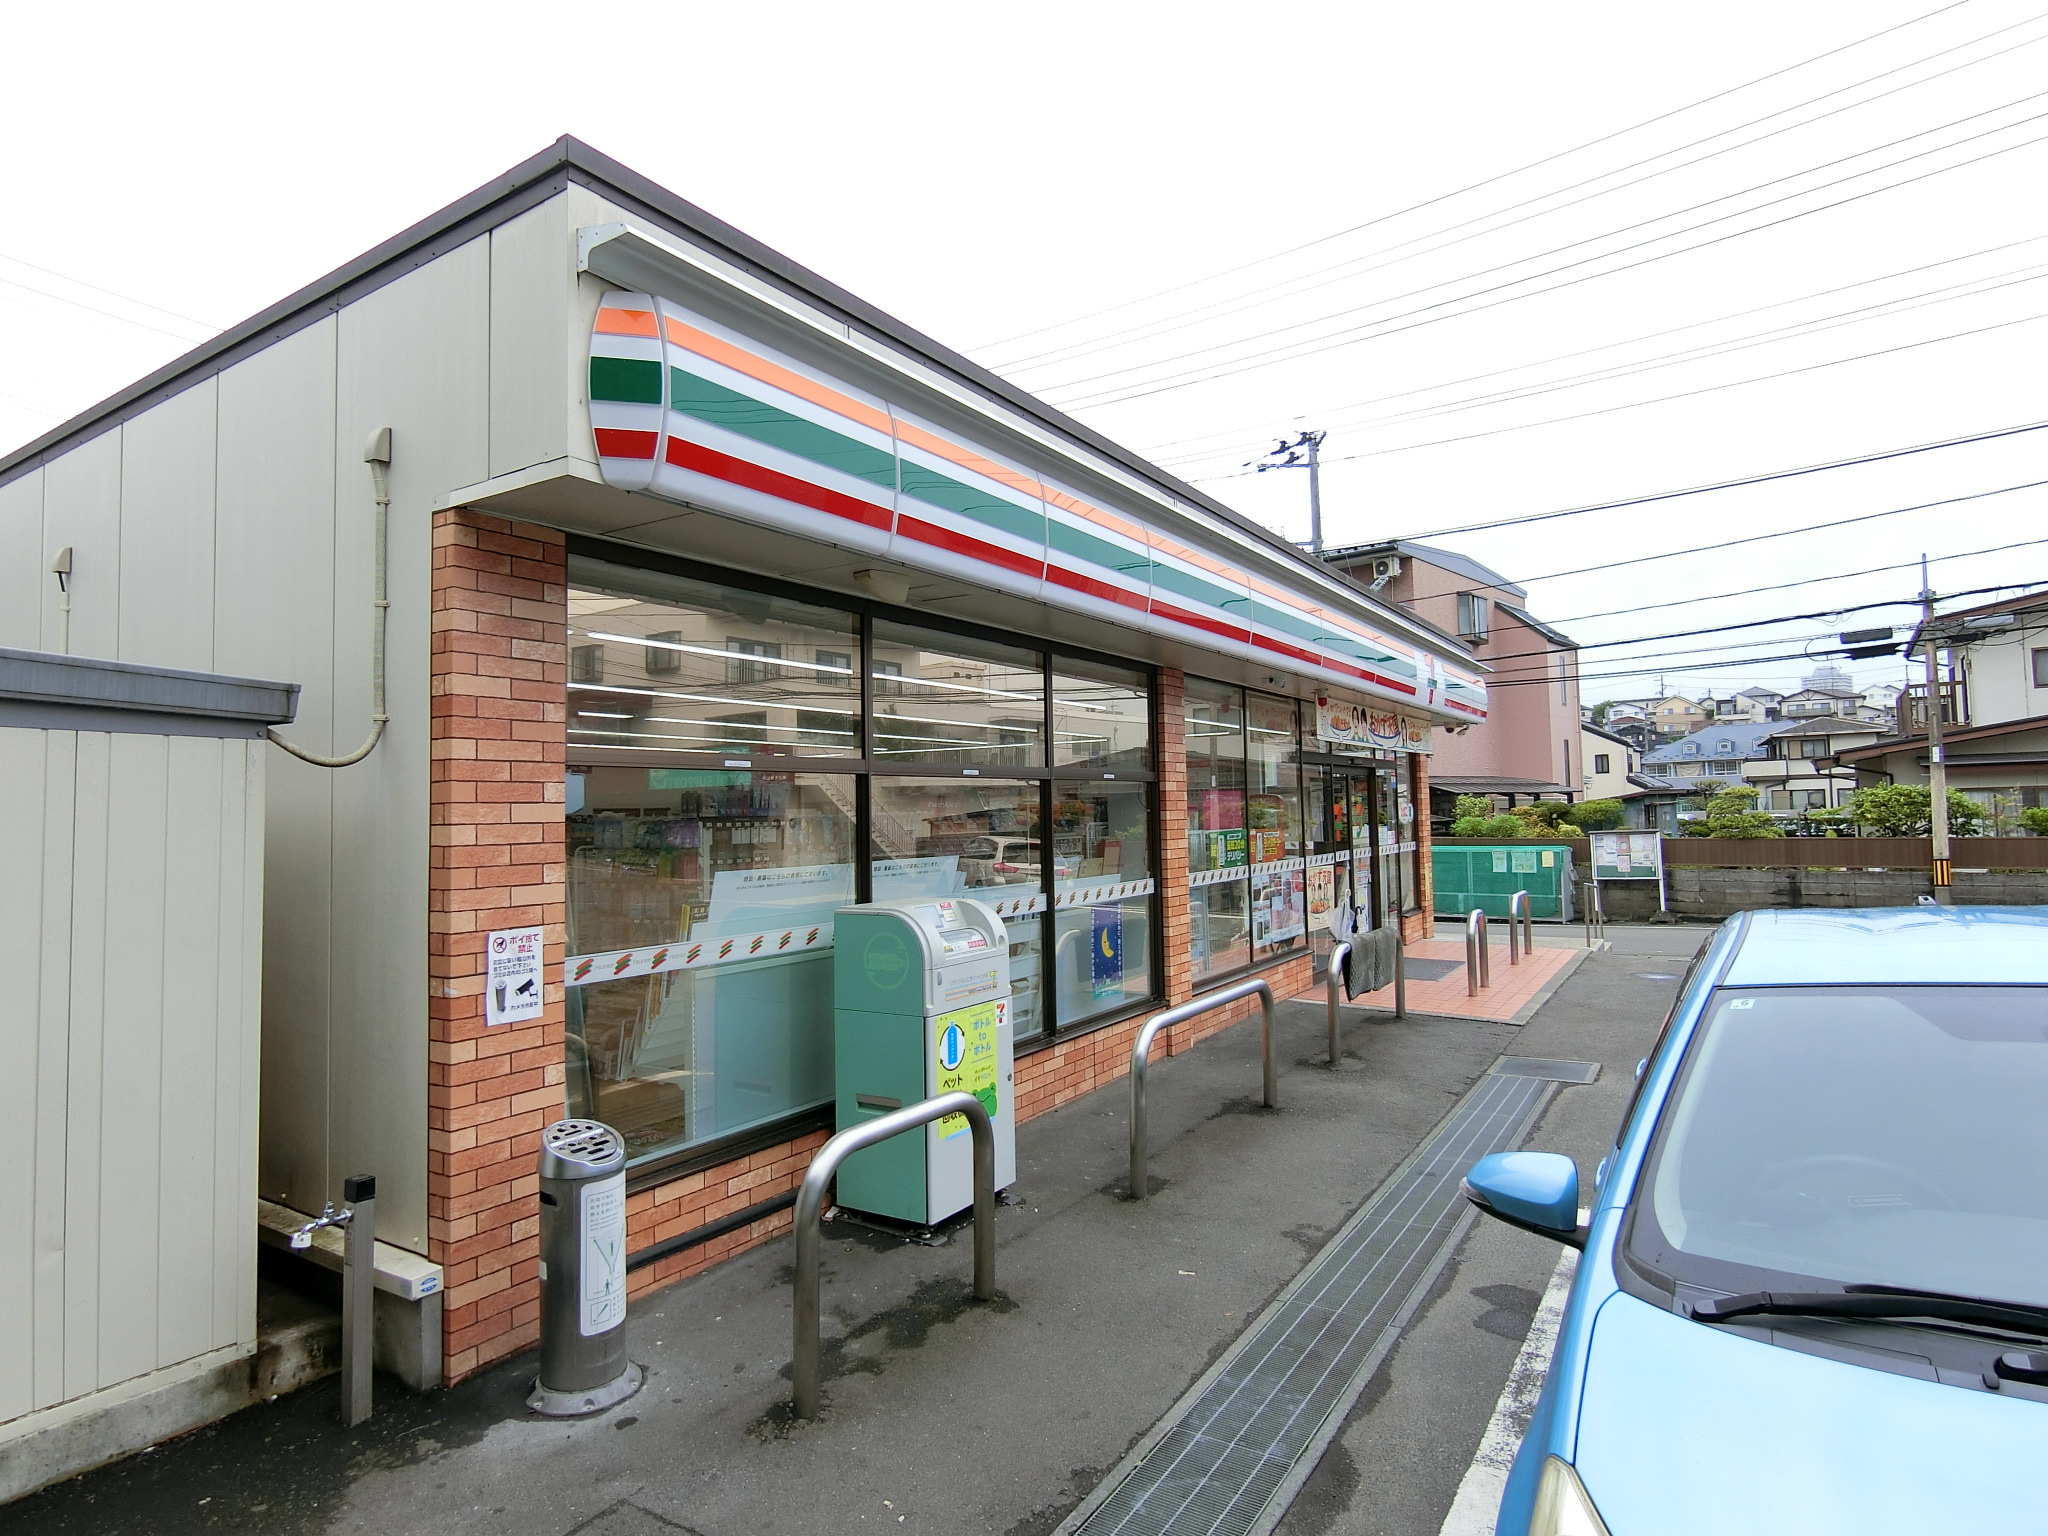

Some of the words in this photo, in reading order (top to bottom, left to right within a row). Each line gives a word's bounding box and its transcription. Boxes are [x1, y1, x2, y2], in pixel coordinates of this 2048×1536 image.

[509, 933, 540, 945] ポイ捨て
[518, 943, 533, 954] 禁止
[973, 1017, 991, 1030] ボトル
[979, 1032, 987, 1041] to
[973, 1042, 991, 1056] ボトル
[943, 1073, 963, 1088] ペット
